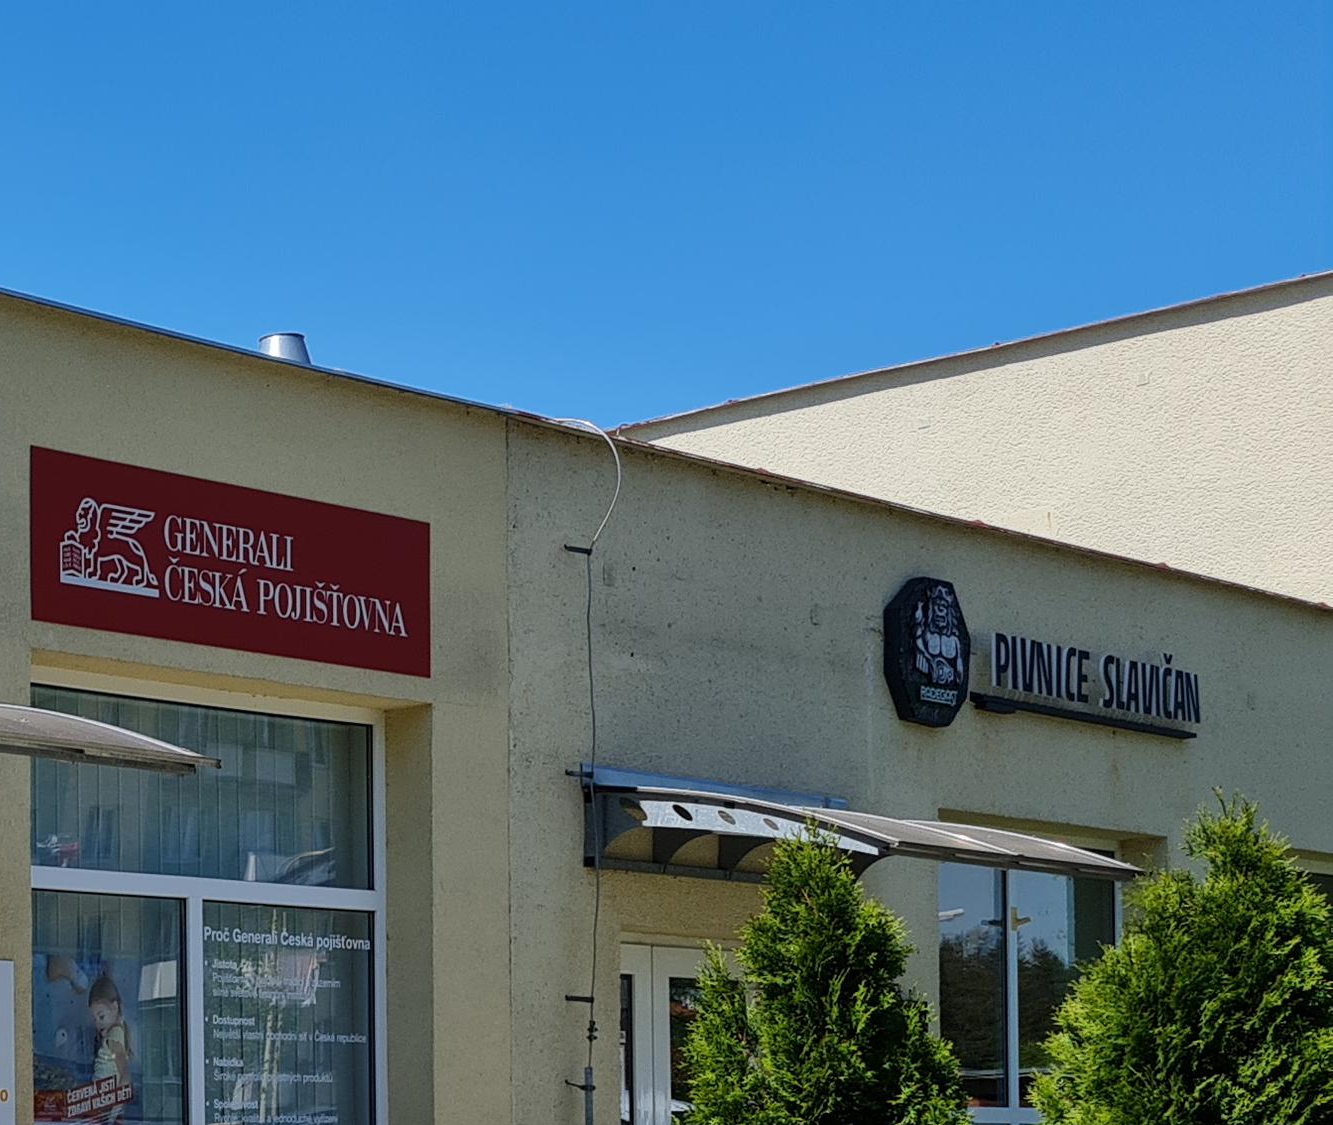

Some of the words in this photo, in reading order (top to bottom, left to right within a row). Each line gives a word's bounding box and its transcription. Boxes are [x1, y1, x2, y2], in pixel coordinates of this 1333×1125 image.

[163, 514, 294, 573] GENERALI
[164, 566, 249, 615] ČESKÁ
[256, 581, 409, 639] POJIŠŤOVNA
[992, 632, 1090, 704] PIVNICE
[1099, 652, 1201, 724] SLAVIČAN
[204, 926, 230, 942] Proč
[233, 928, 278, 945] Generali
[280, 927, 314, 948] Česká
[316, 934, 371, 951] pojišťovna
[213, 1015, 255, 1027] Dostupnost
